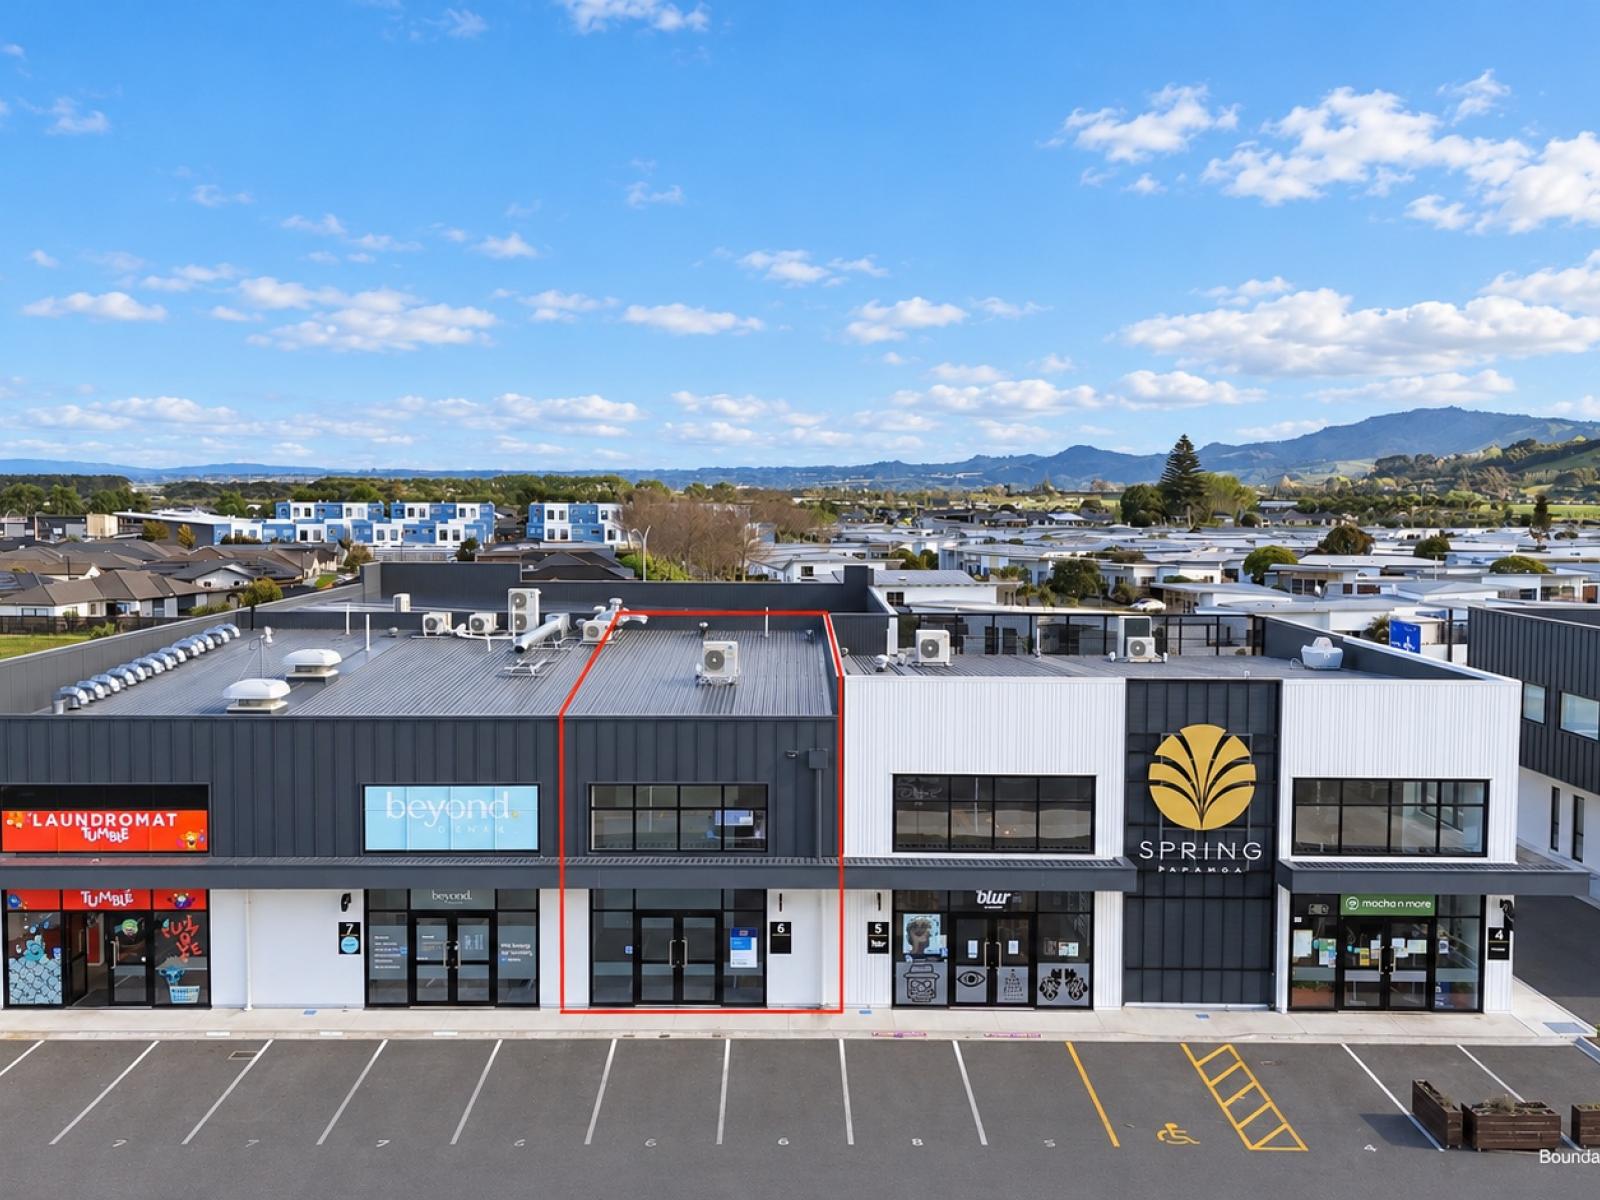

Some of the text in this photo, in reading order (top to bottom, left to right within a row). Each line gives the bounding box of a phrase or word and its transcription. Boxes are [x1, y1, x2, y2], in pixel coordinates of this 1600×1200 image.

[32, 813, 178, 827] LAUNDROMAT
[1139, 841, 1262, 860] SPRING
[976, 889, 1012, 905] blur
[1361, 899, 1397, 908] mocha
[1405, 900, 1432, 908] more
[345, 923, 354, 935] 7
[777, 922, 785, 933] 6
[874, 923, 883, 934] 5
[1494, 929, 1504, 940] 4
